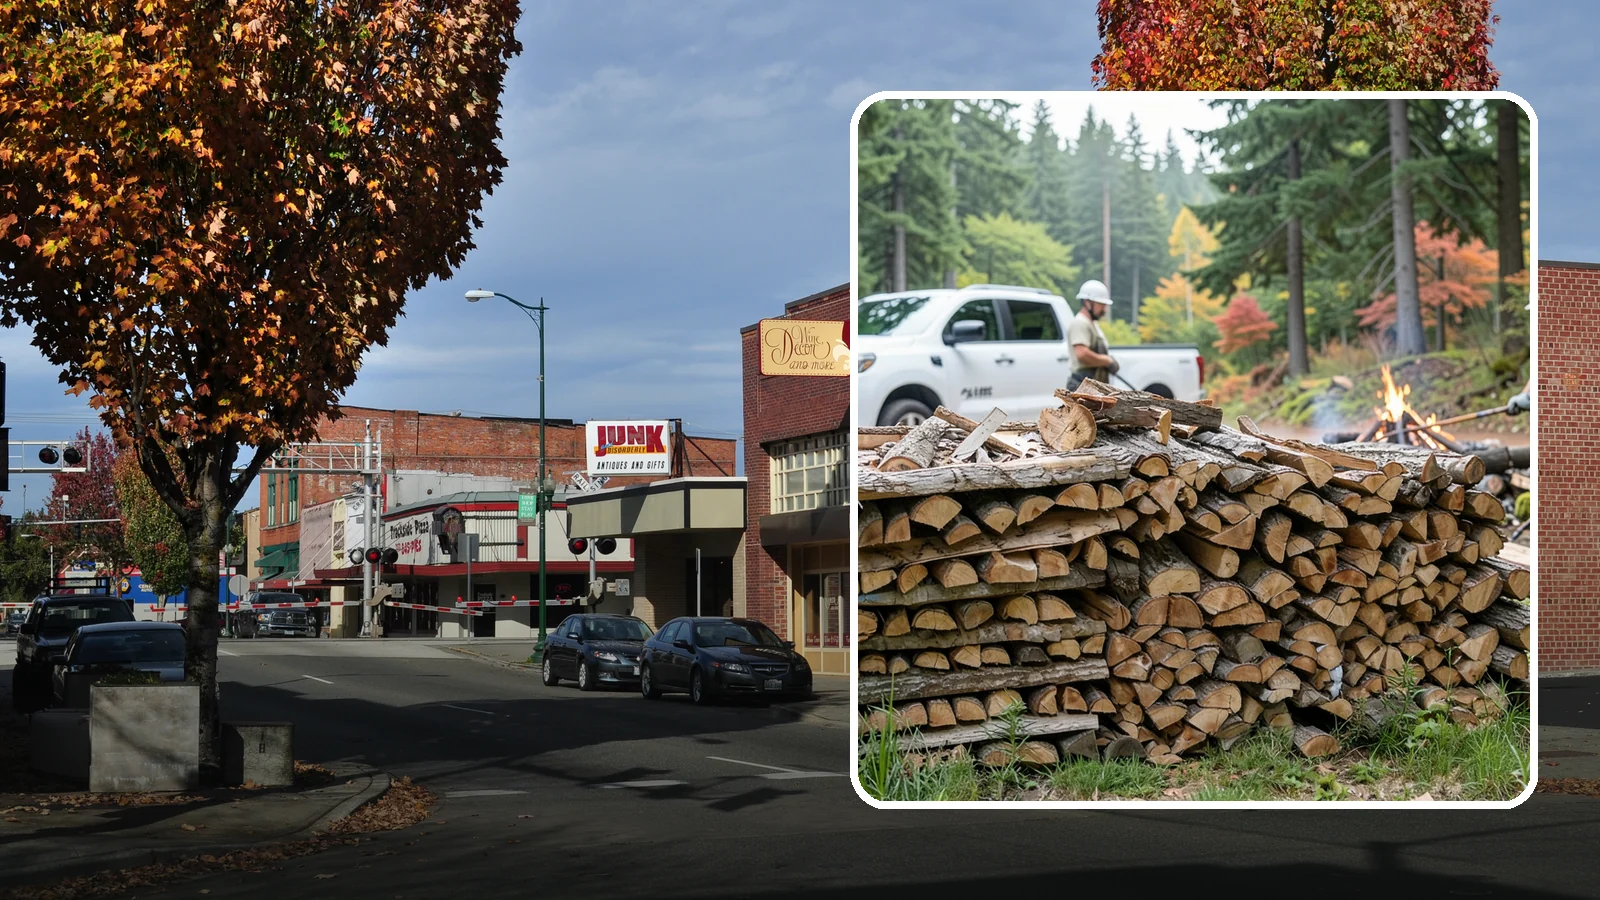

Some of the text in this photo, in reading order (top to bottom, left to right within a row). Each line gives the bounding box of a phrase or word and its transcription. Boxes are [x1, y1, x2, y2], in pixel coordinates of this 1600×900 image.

[595, 425, 665, 457] JUNK
[596, 460, 665, 470] ANTIQUES AND GIFTS
[573, 473, 588, 491] RAIL
[352, 498, 365, 511] CRO
[414, 519, 429, 534] Pizza
